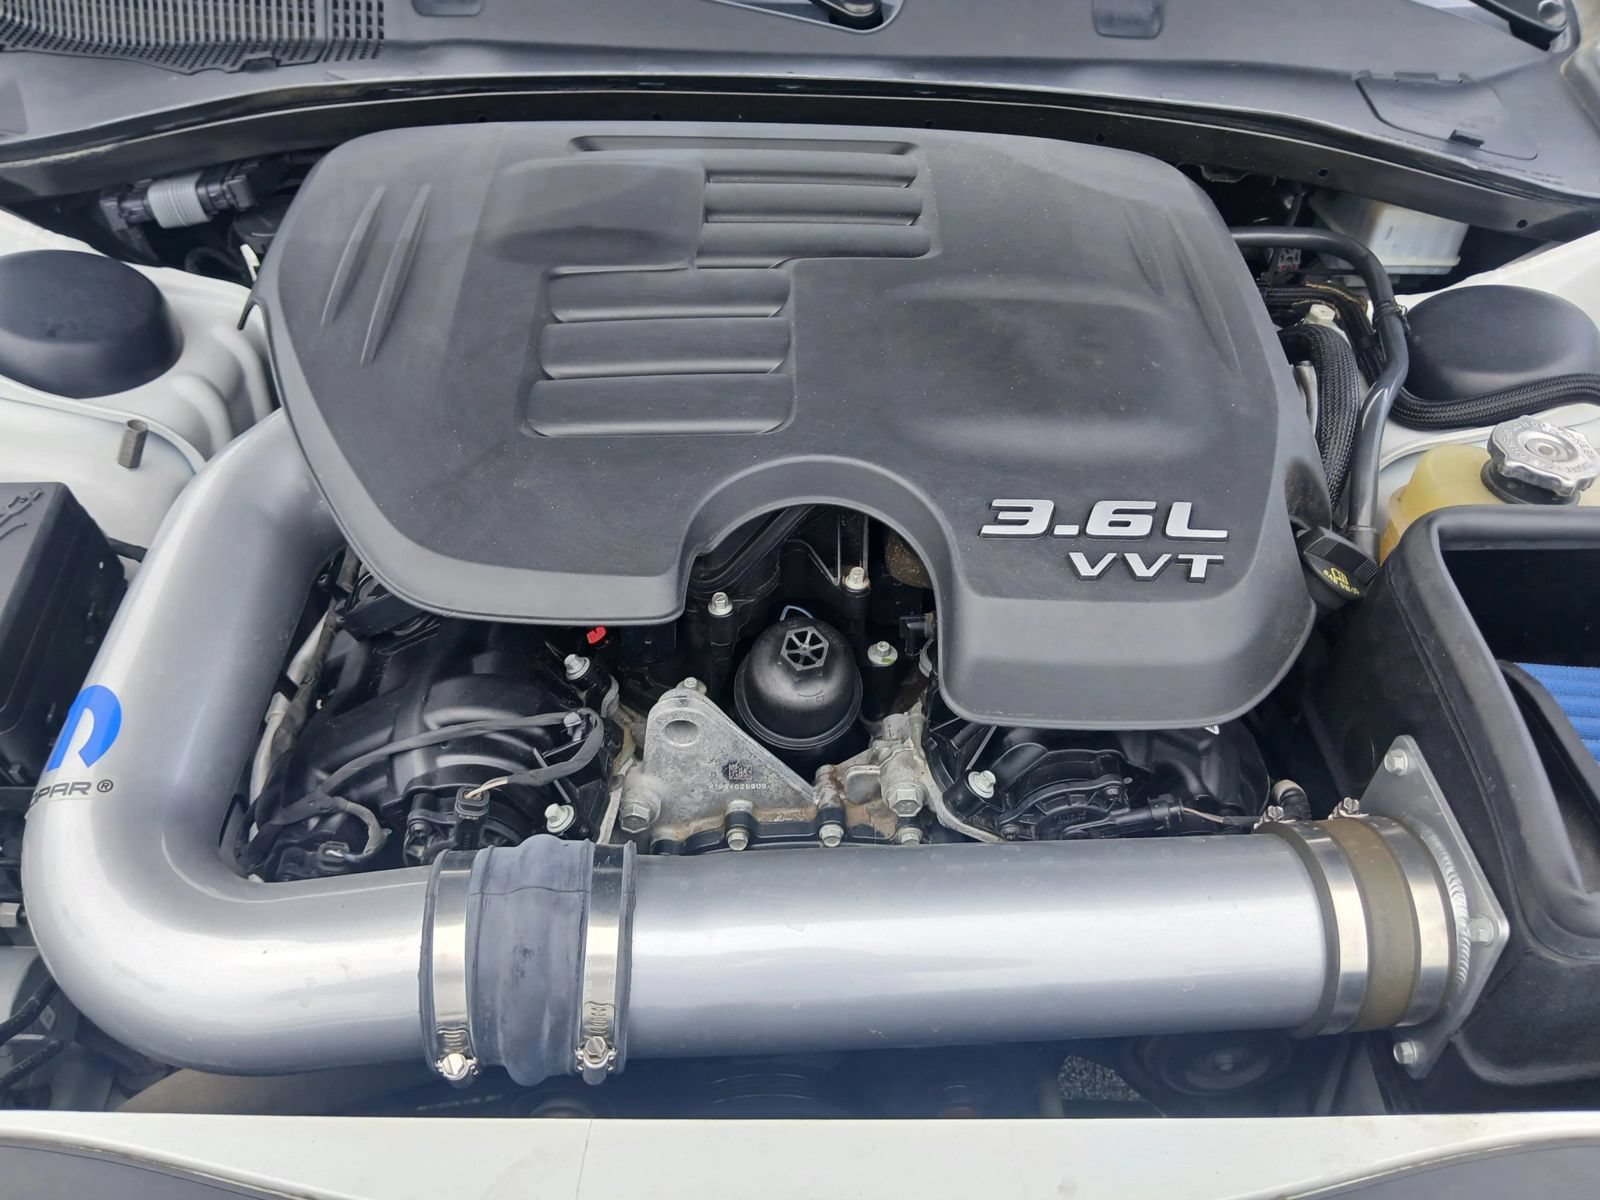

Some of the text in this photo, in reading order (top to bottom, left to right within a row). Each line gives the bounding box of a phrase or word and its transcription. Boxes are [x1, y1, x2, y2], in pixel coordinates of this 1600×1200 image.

[980, 499, 1228, 540] 3.6L
[1068, 552, 1224, 582] VVT
[30, 781, 92, 807] PAR
